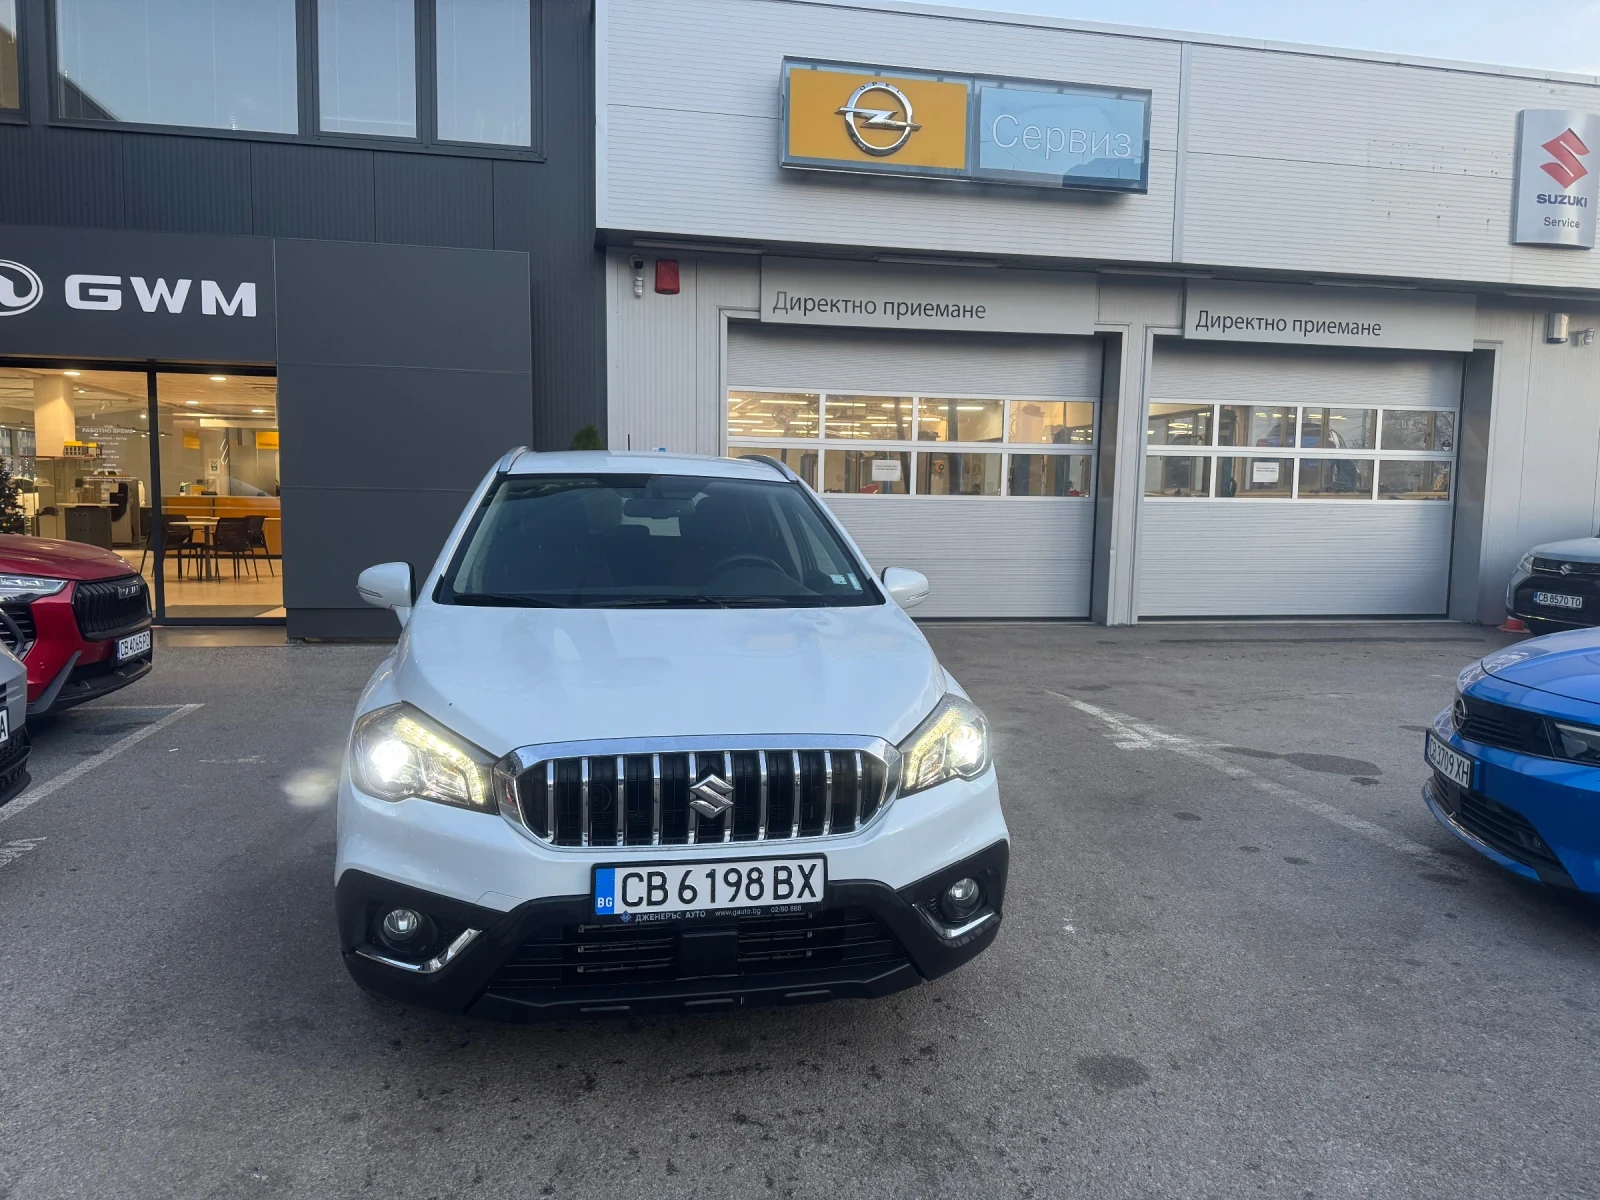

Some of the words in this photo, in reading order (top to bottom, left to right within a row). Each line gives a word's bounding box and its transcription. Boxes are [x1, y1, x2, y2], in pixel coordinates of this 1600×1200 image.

[991, 113, 1132, 160] Сервиз
[1536, 193, 1588, 208] SUZUKI
[1543, 216, 1580, 229] Service
[65, 274, 257, 317] GWM
[772, 290, 877, 316] Директно
[883, 300, 987, 320] приемане
[1195, 310, 1288, 333] Директно
[1292, 318, 1382, 337] приемане
[1455, 757, 1470, 785] XH
[621, 870, 669, 907] CB
[677, 866, 765, 905] 6198
[772, 863, 818, 901] BX
[597, 896, 613, 908] BG
[715, 907, 762, 917] www.gauto.bg
[635, 912, 682, 923] ДЖЕНЕРЪС
[685, 910, 706, 919] АУТО
